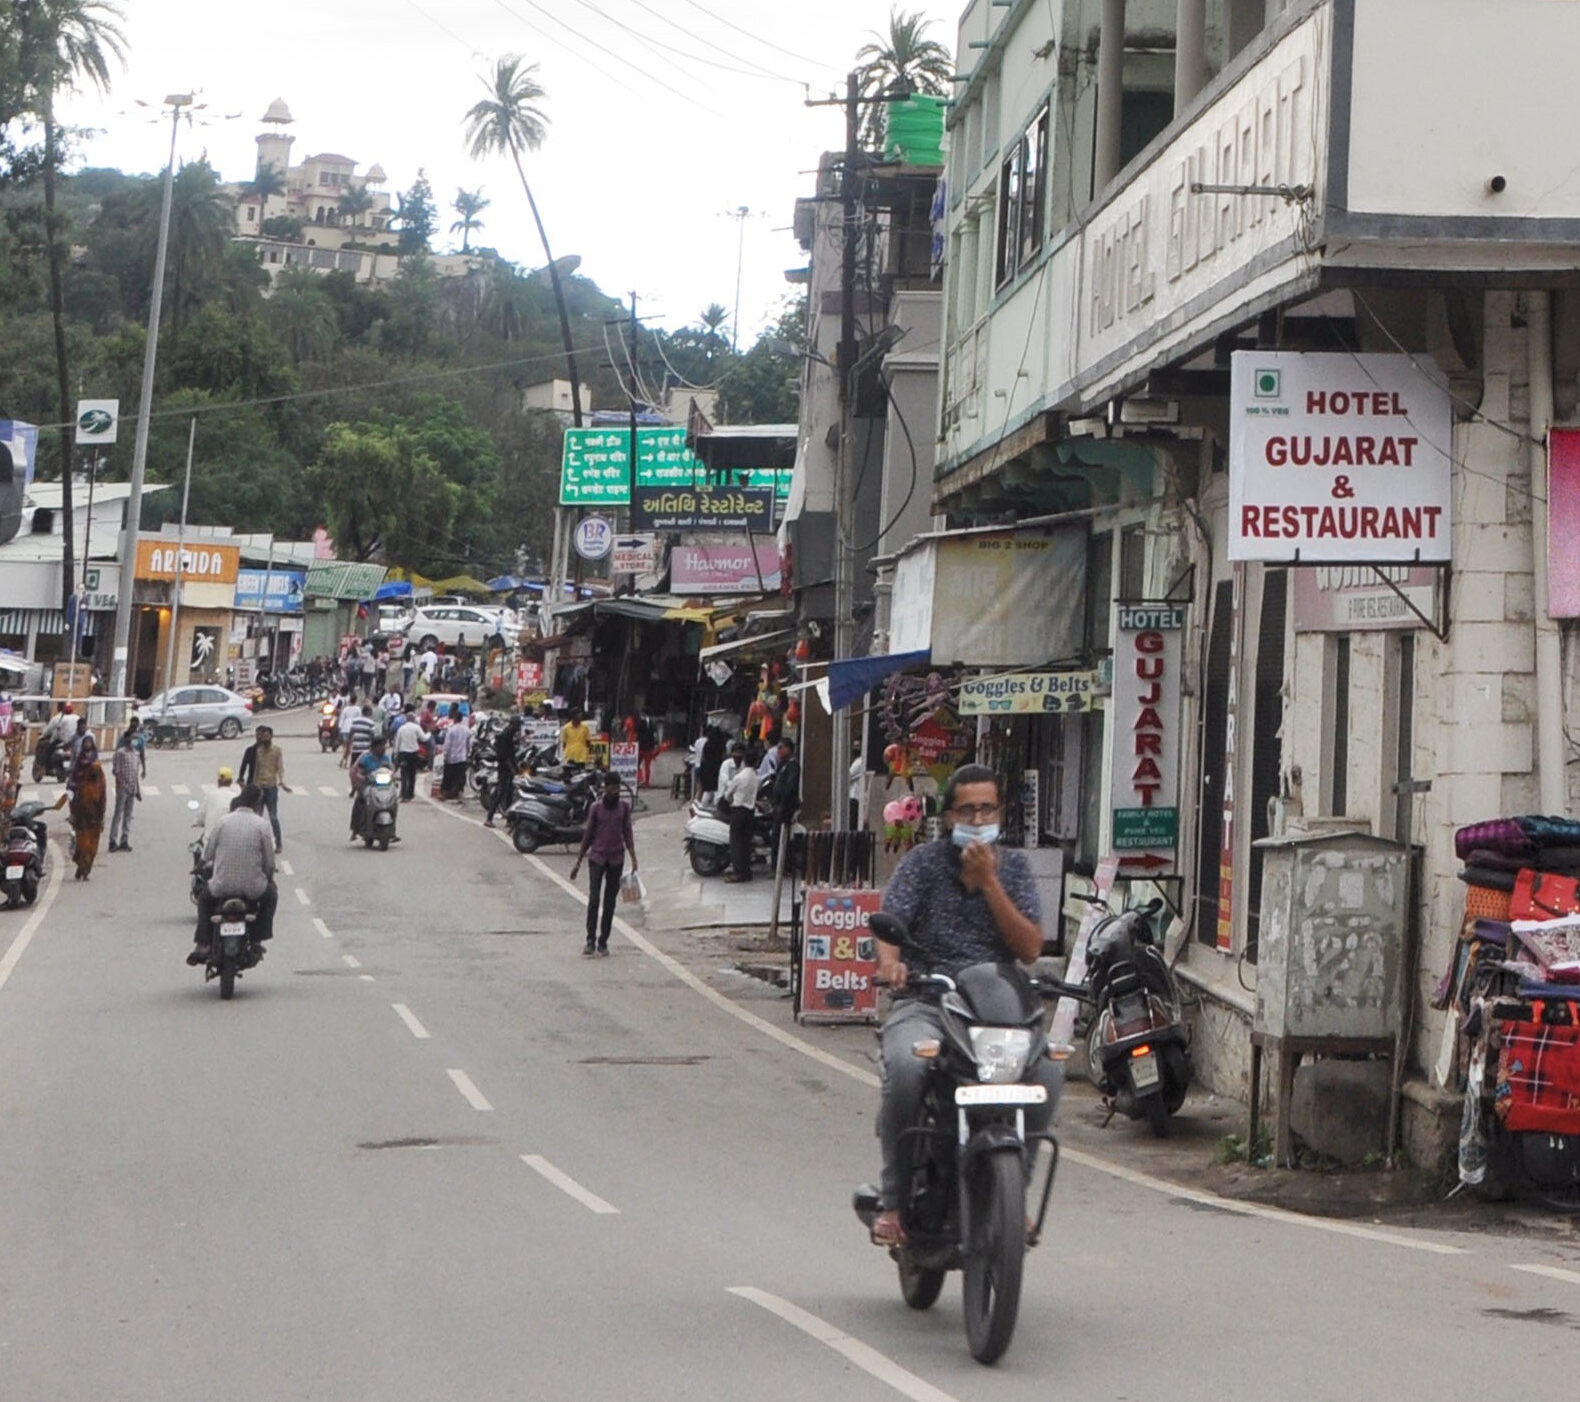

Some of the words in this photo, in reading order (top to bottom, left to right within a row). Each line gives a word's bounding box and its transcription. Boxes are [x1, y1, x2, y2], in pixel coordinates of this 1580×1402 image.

[1306, 390, 1408, 416] HOTEL
[1265, 435, 1419, 466] GUJARAT
[1331, 474, 1355, 499] &
[1241, 504, 1442, 540] RESTAURANT
[613, 552, 653, 561] MEDICAL
[1120, 609, 1182, 630] HOTEL
[964, 678, 1026, 699] Goggles
[1030, 676, 1044, 694] &
[1048, 675, 1089, 694] Belts
[1133, 631, 1164, 807] GUJARAT
[810, 905, 872, 931] Goggle
[834, 938, 854, 961] &
[815, 969, 868, 991] Belts
